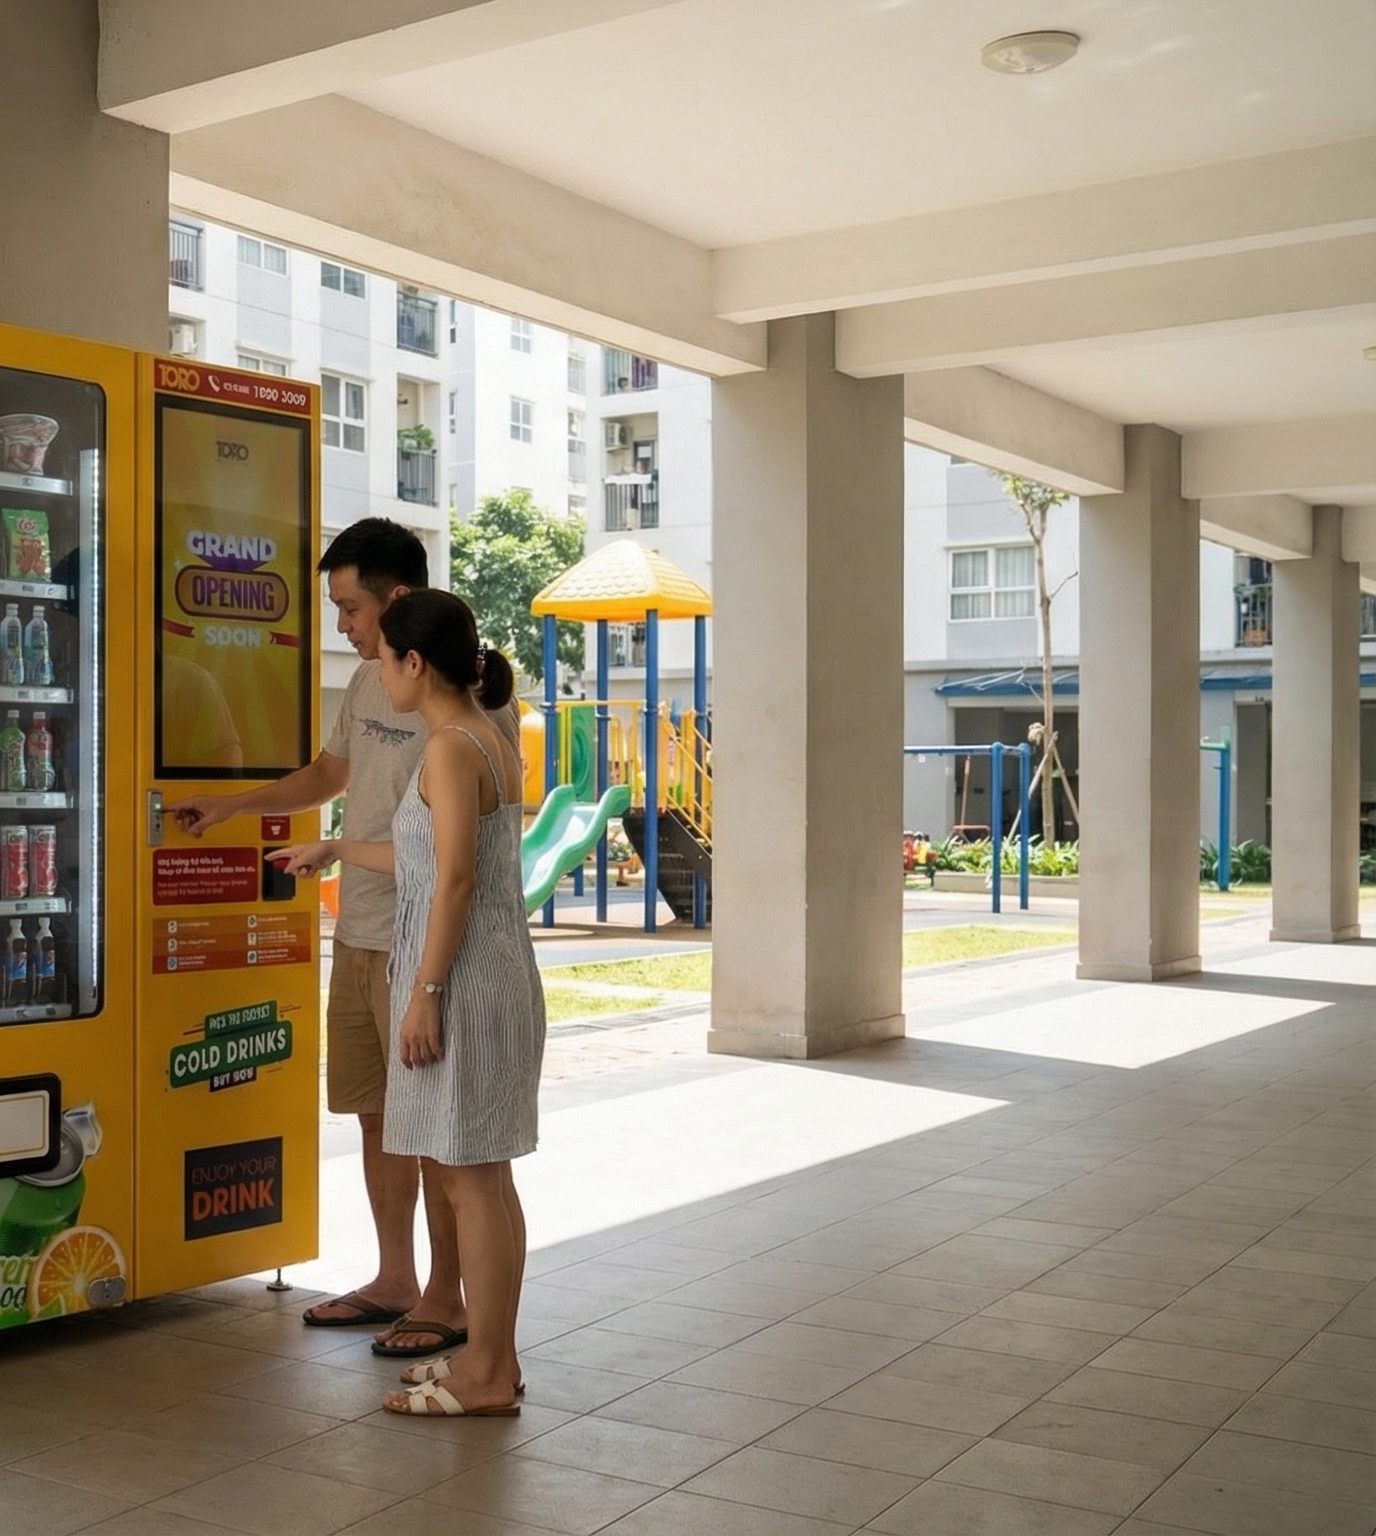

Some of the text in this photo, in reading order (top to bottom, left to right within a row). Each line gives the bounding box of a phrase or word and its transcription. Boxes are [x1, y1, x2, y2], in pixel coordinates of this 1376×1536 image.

[159, 364, 200, 391] TORO
[187, 530, 277, 562] GRAND
[192, 575, 274, 611] OPENING
[205, 626, 262, 647] SOON
[174, 1028, 287, 1078] COLD DRINKS
[191, 1161, 236, 1185] ENJOY
[192, 1178, 275, 1222] DRINK
